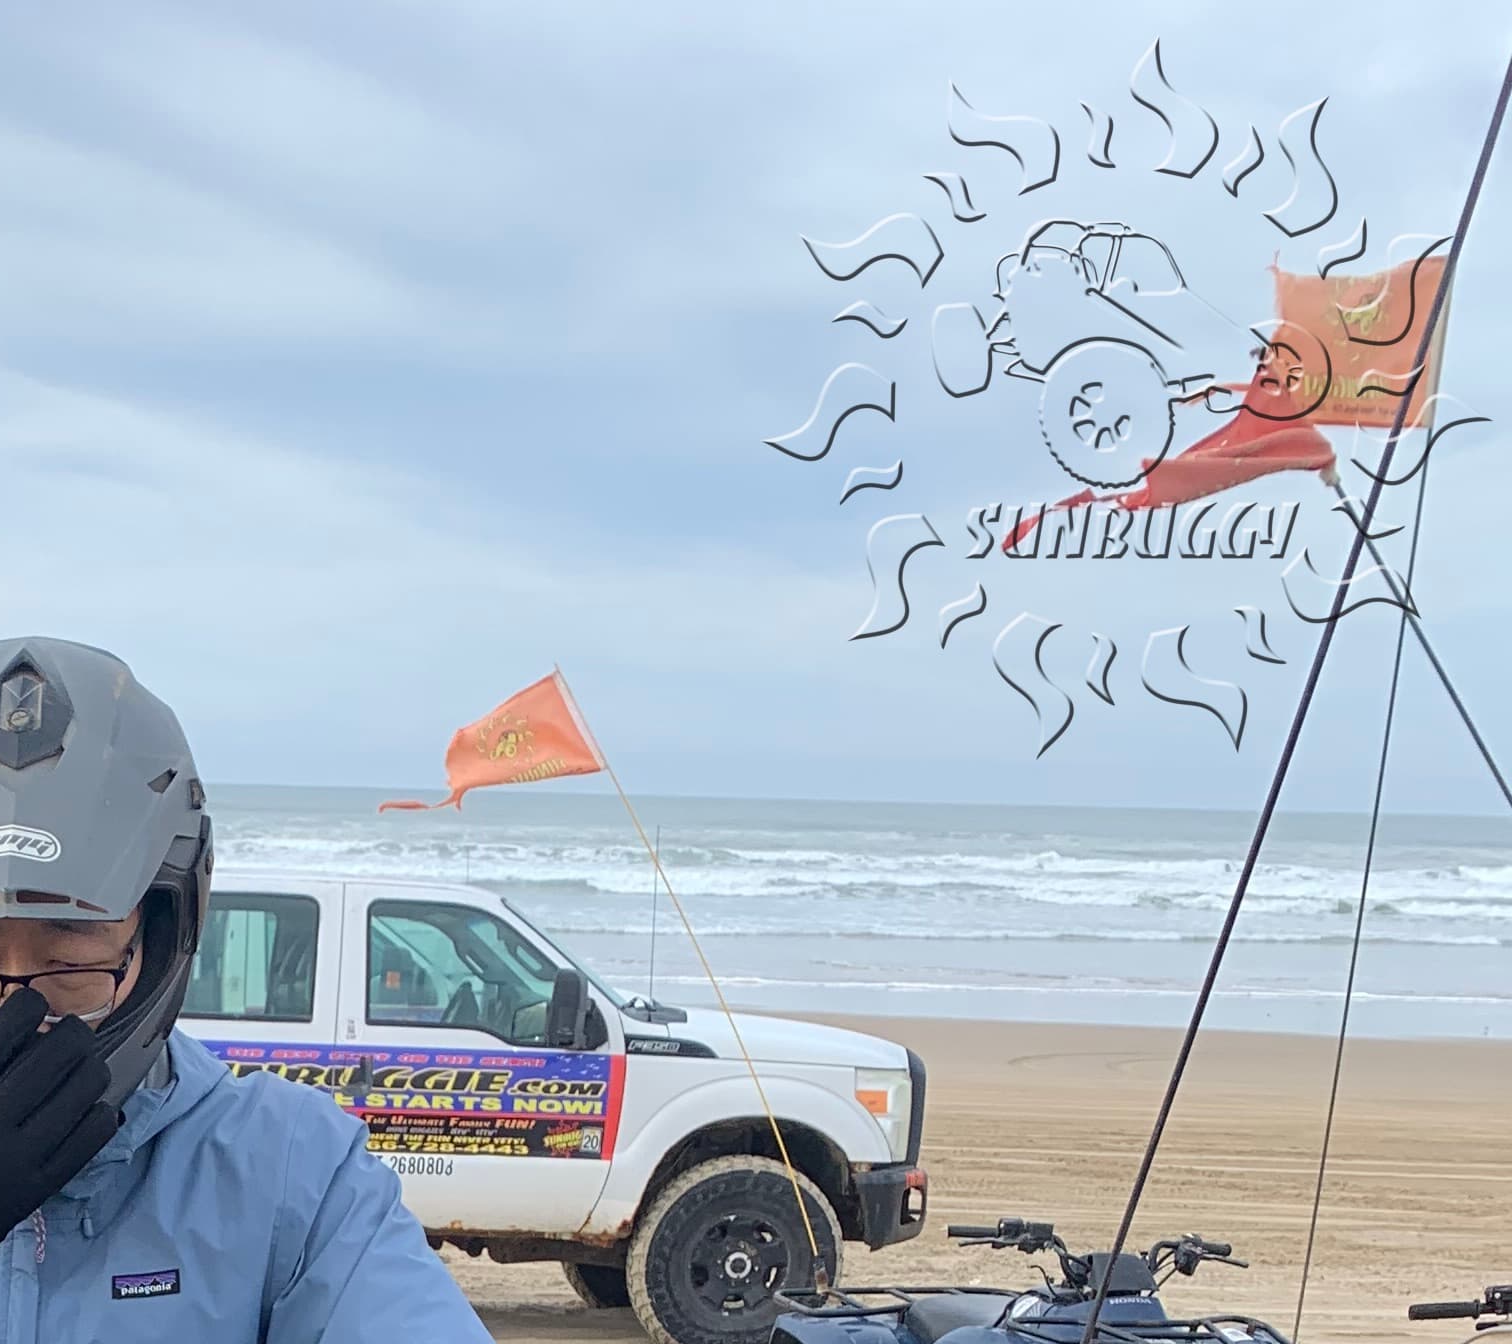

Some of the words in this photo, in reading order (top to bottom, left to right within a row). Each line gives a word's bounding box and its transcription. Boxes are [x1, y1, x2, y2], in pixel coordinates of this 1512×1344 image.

[365, 1093, 502, 1111] STARTS
[513, 1098, 603, 1115] NOW!
[495, 1118, 536, 1130] FUN!
[366, 1141, 529, 1155] 66-728-4443
[584, 1135, 599, 1149] 20
[121, 1282, 172, 1296] patagonia
